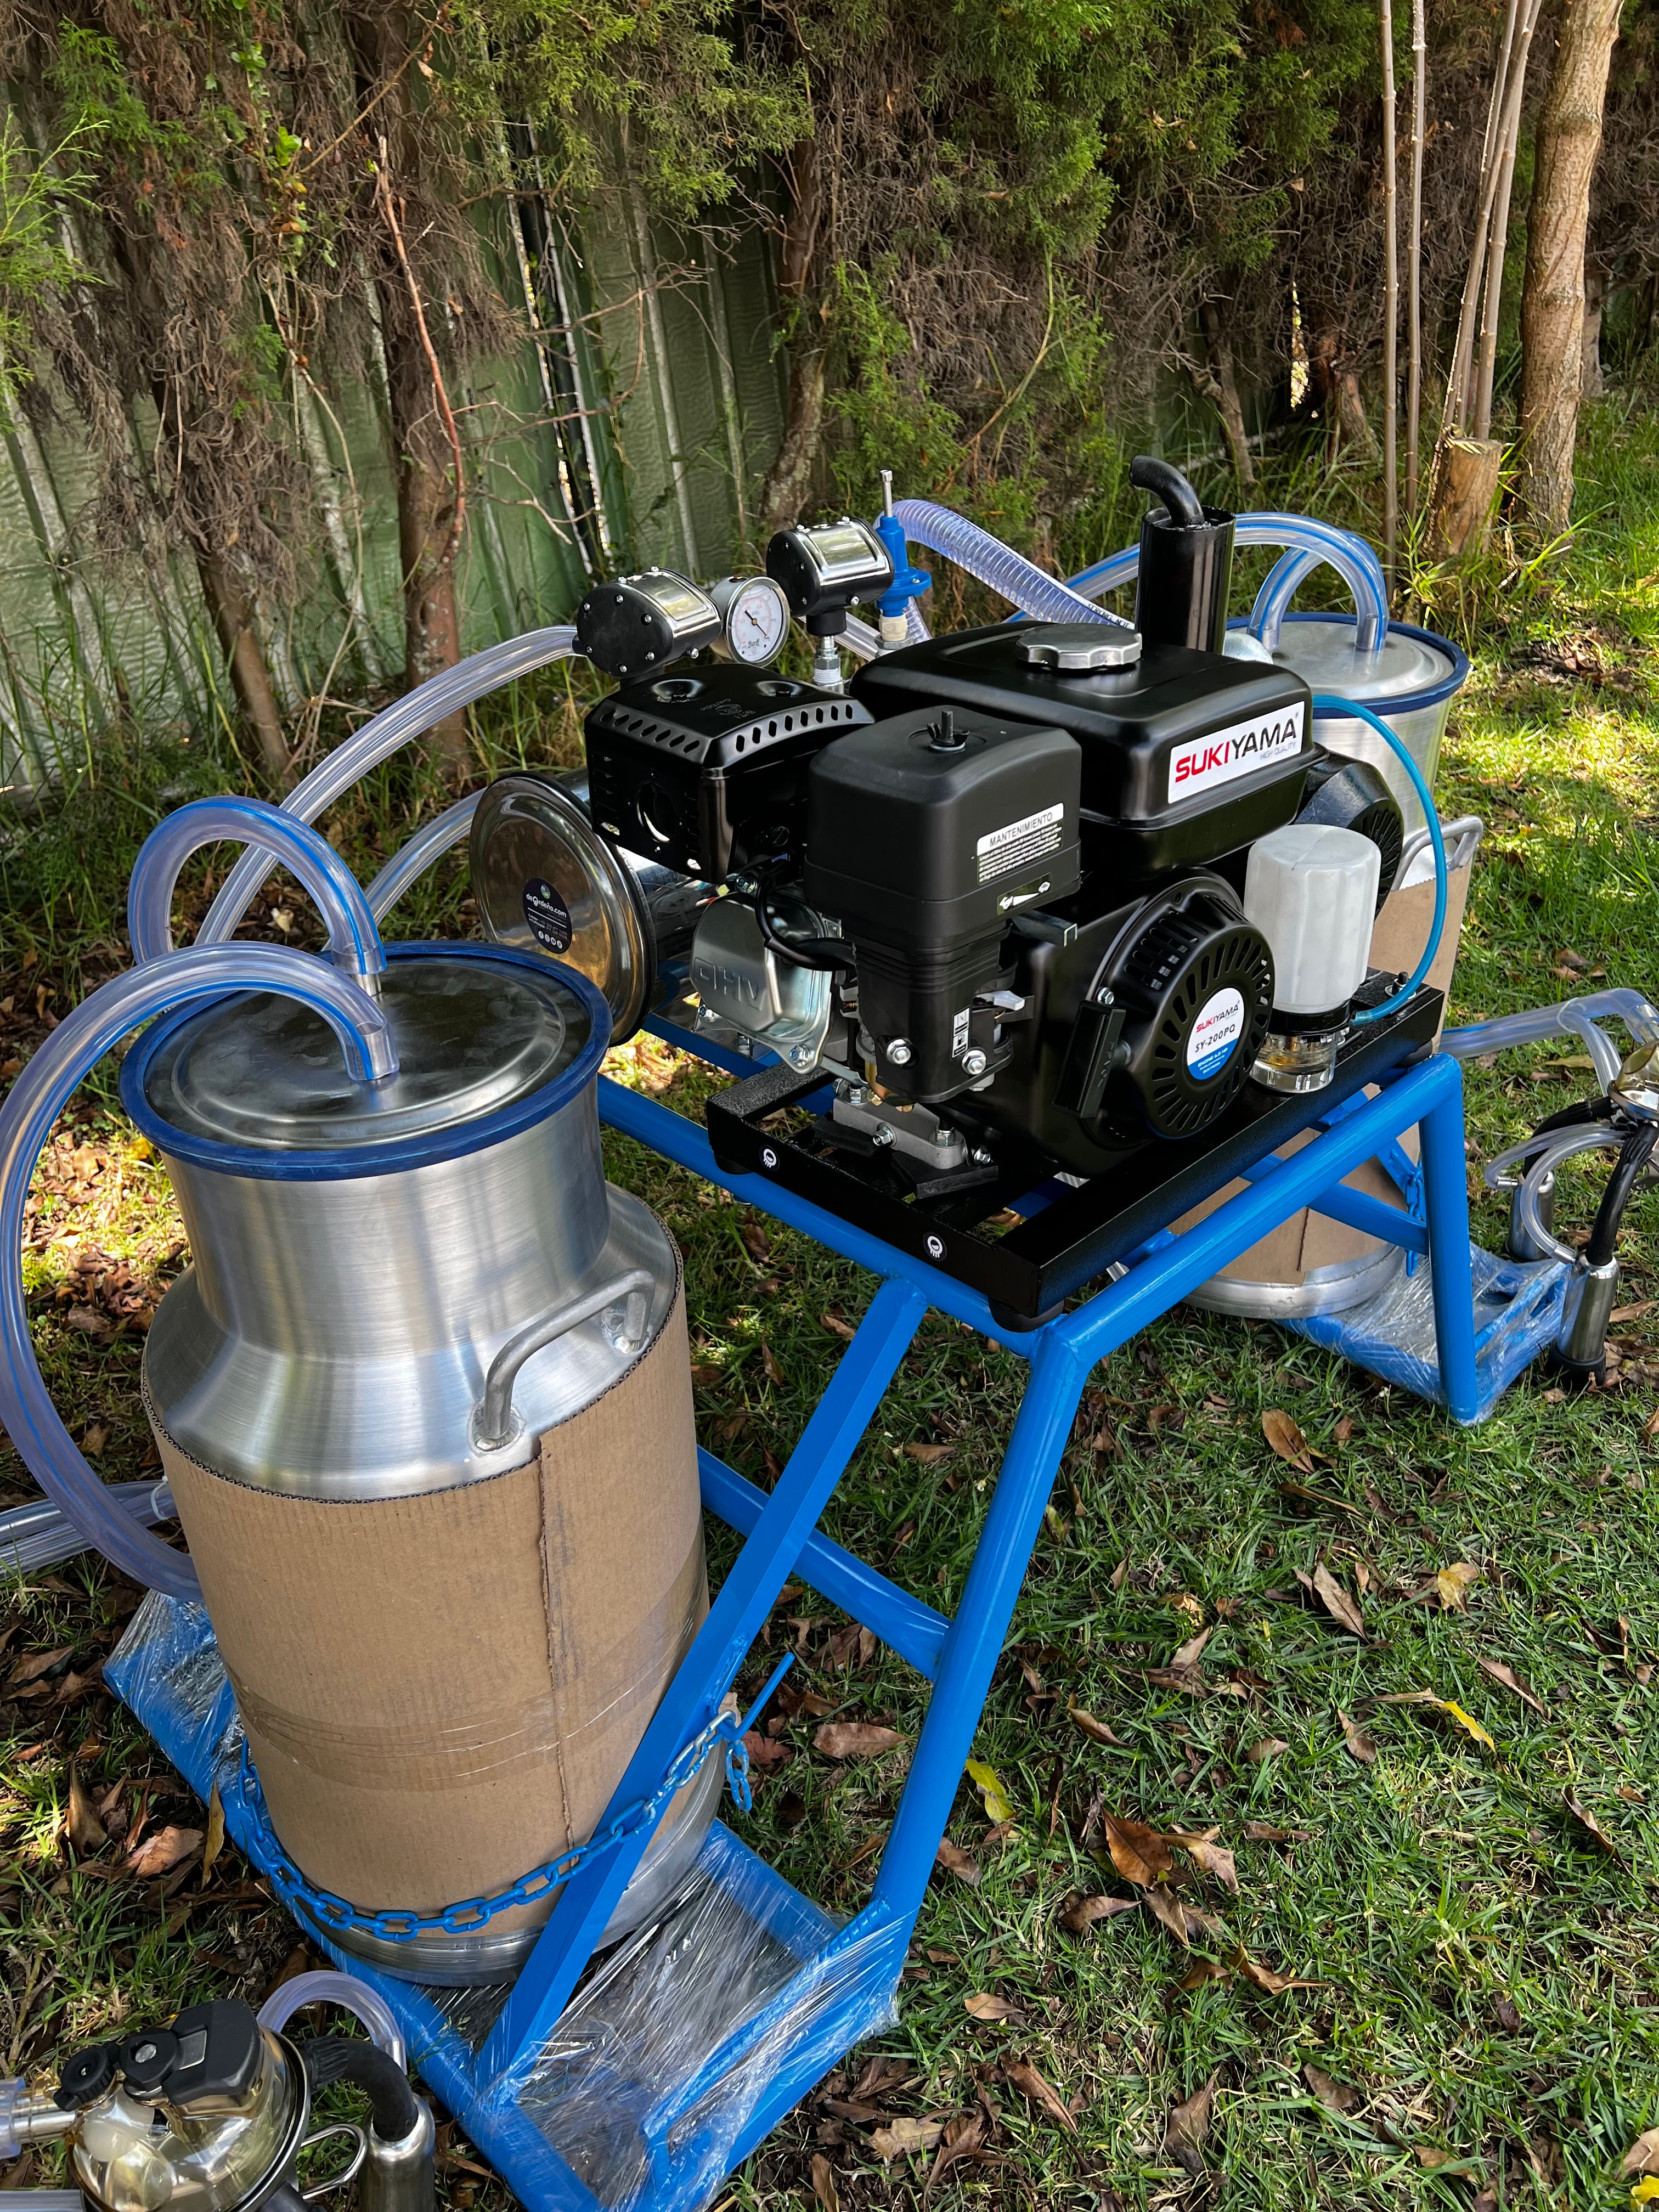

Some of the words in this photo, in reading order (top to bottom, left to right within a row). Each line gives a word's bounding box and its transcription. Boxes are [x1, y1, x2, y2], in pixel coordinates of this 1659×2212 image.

[1087, 604, 1113, 620] STRONG
[1175, 718, 1297, 783] SUKIYAMA
[989, 812, 1053, 848] MANTENIMIENTO
[1196, 1004, 1239, 1033] SUKIYAMA
